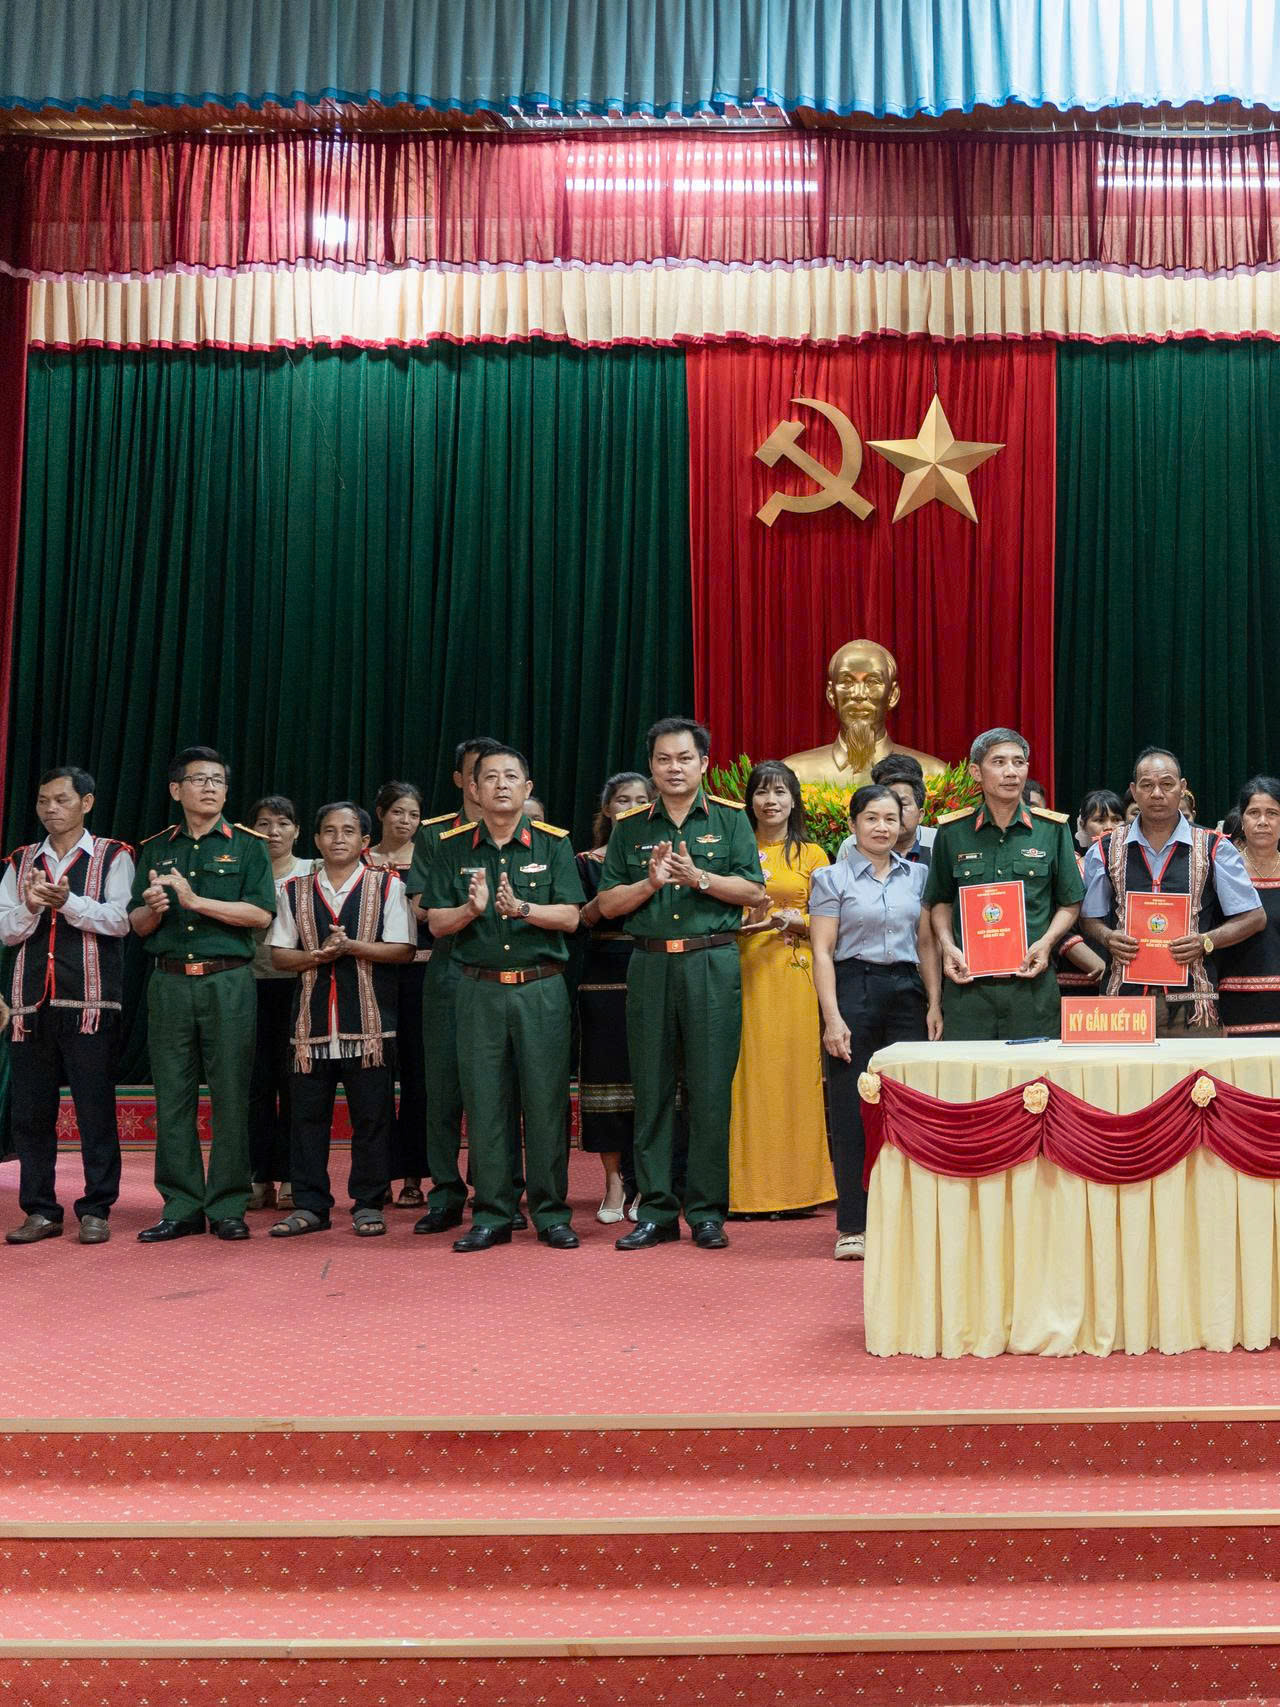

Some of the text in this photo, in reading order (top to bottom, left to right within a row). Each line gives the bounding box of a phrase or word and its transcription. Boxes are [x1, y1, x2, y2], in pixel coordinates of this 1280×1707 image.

[1069, 1006, 1147, 1035] KÝ GẮN KẾT HỘ
